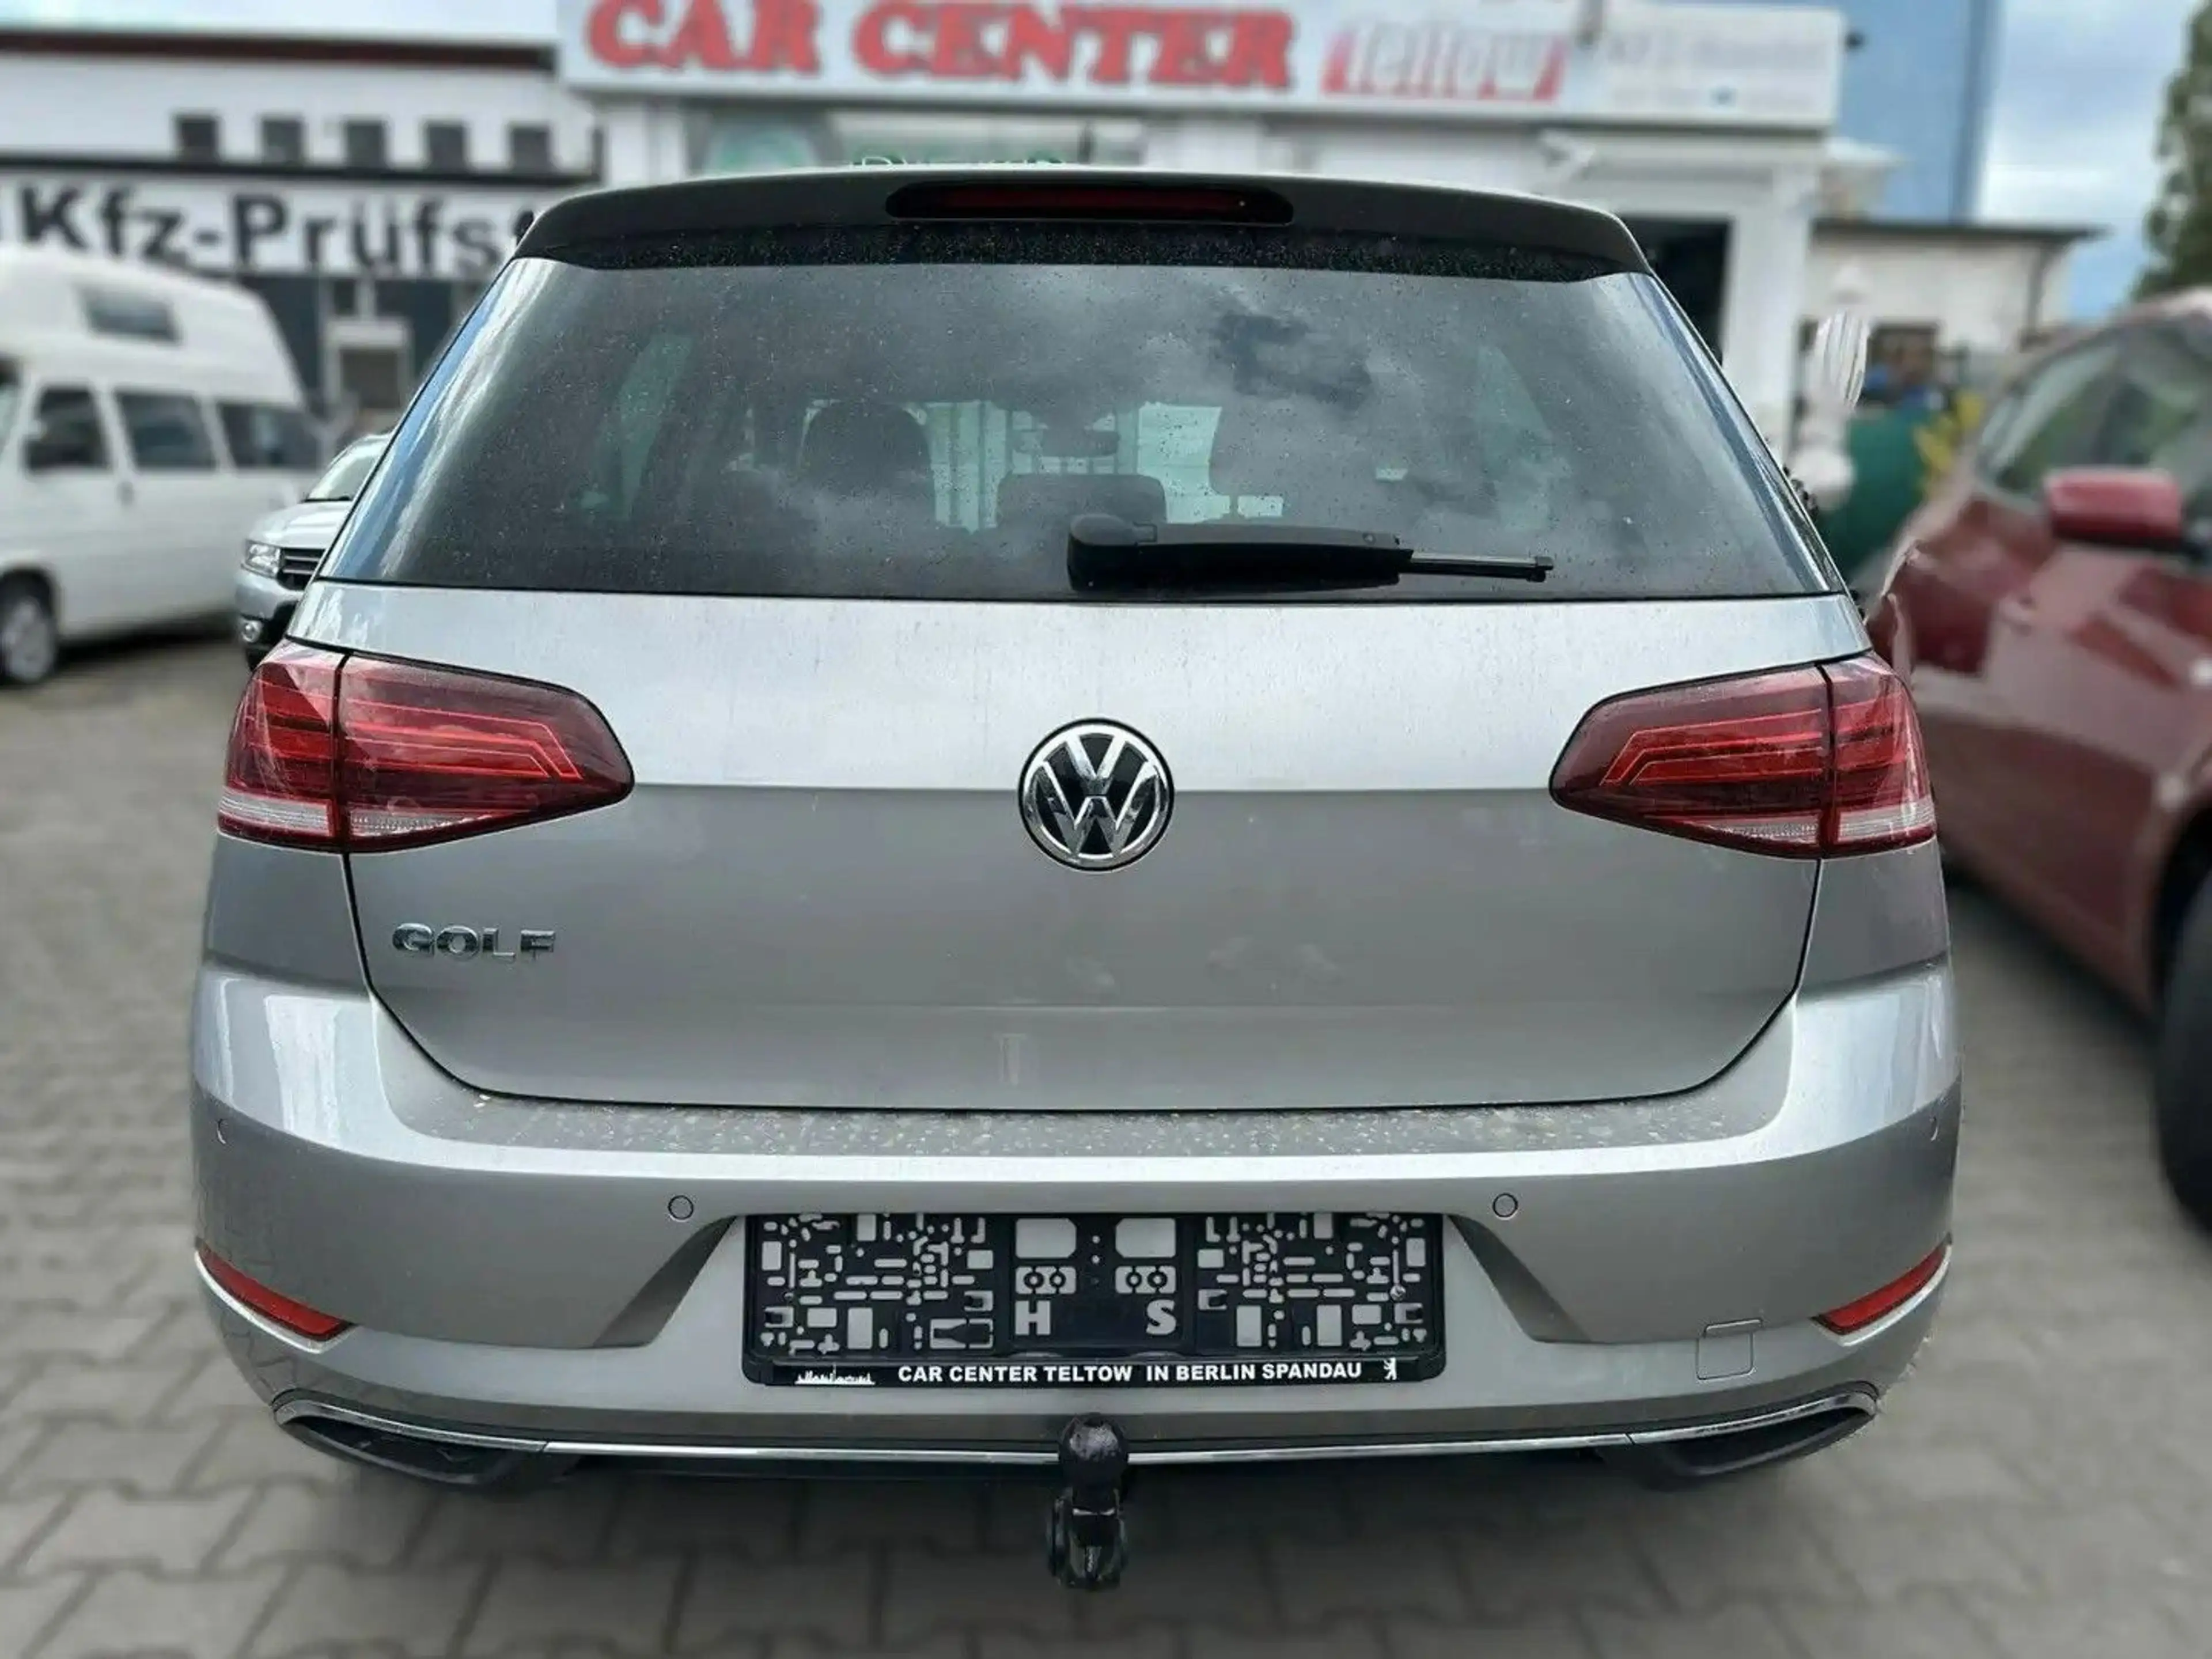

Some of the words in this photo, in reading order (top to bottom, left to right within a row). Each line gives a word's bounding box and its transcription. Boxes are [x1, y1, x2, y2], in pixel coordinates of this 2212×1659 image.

[585, 0, 824, 78] CAR
[851, 0, 1293, 89] CENTER
[392, 923, 555, 960] GOLF
[1015, 1300, 1051, 1335] H
[1146, 1298, 1176, 1335] S
[897, 1365, 943, 1382] CAR
[949, 1365, 1037, 1382] CENTER
[1043, 1365, 1132, 1382] TELTOW
[1146, 1365, 1169, 1381] IN
[1176, 1363, 1256, 1381] BERLIN
[1262, 1362, 1362, 1380] SPANDAU
